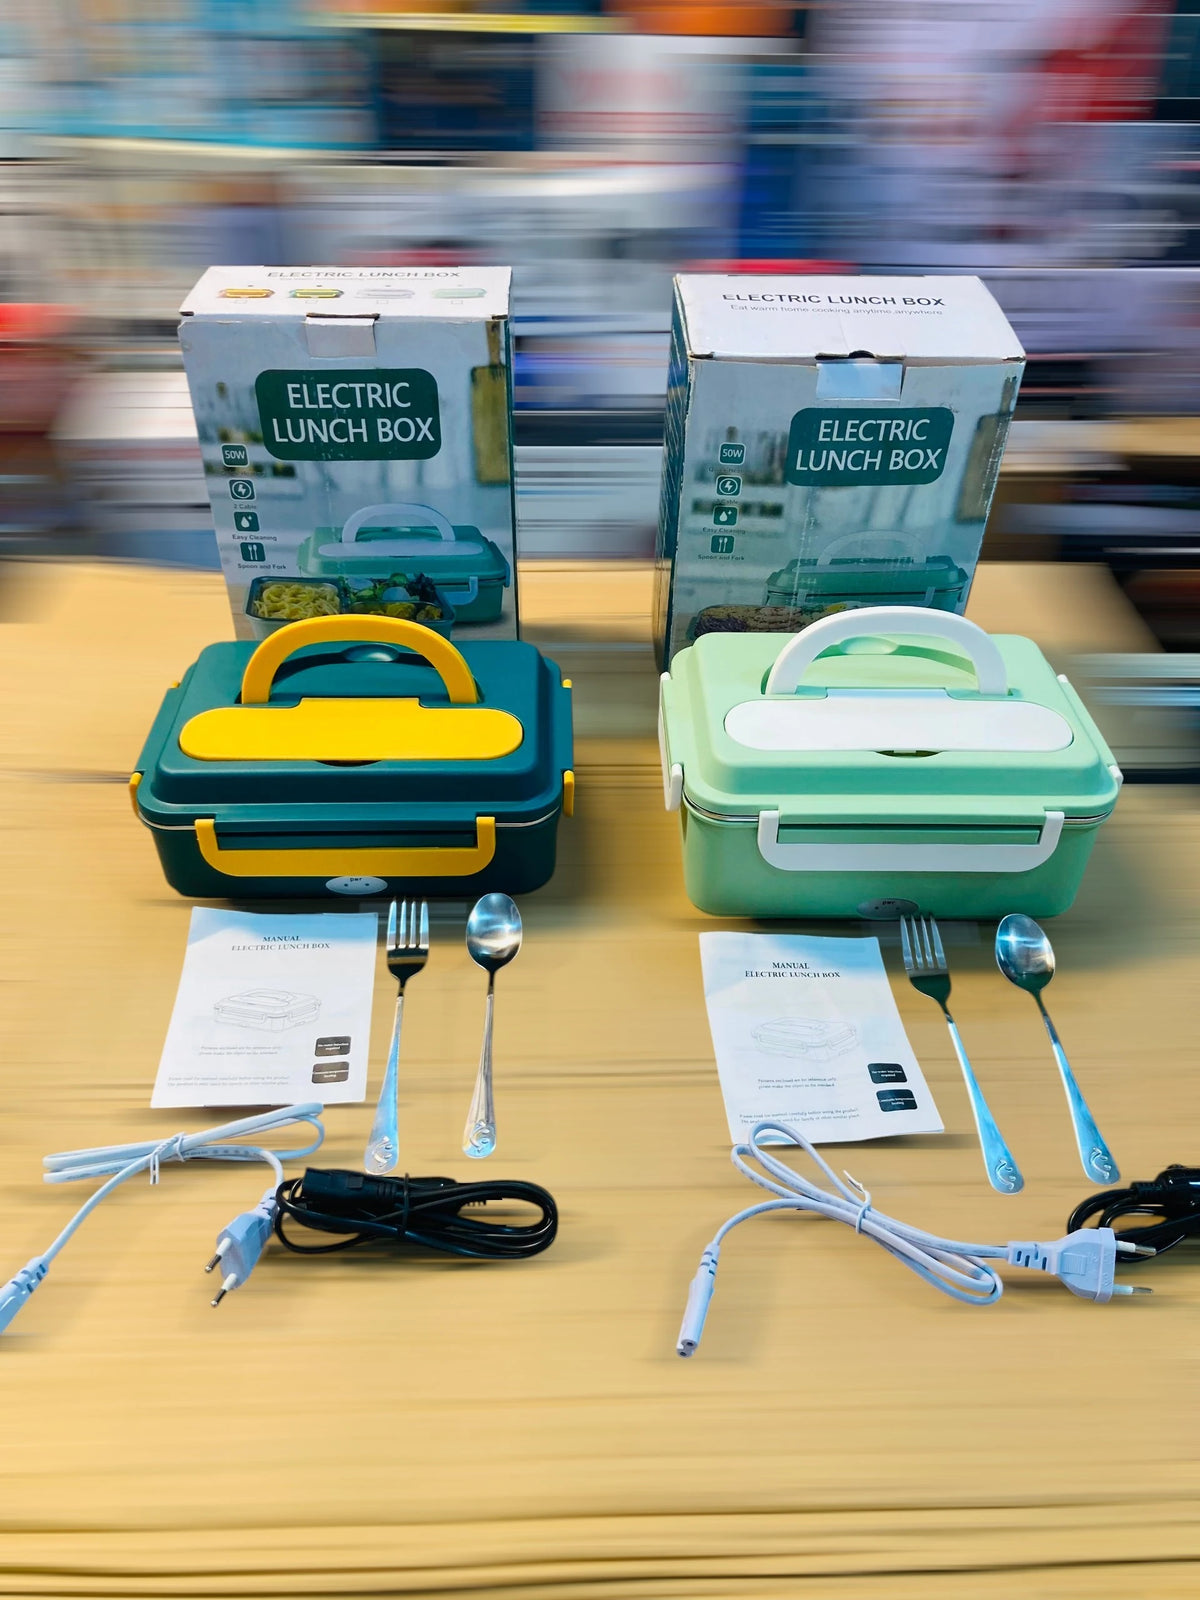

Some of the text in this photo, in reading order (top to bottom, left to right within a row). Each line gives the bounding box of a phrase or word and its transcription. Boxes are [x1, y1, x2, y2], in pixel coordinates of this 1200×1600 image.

[722, 294, 946, 306] ELECTRIC LUNCH BOX
[286, 382, 411, 409] ELECTRIC
[272, 417, 435, 444] LUNCH BOX
[818, 418, 930, 442] ELECTRIC
[224, 450, 245, 459] 50W
[722, 449, 743, 458] 50W
[795, 448, 942, 472] LUNCH BOX
[745, 970, 788, 978] ELECTRIC
